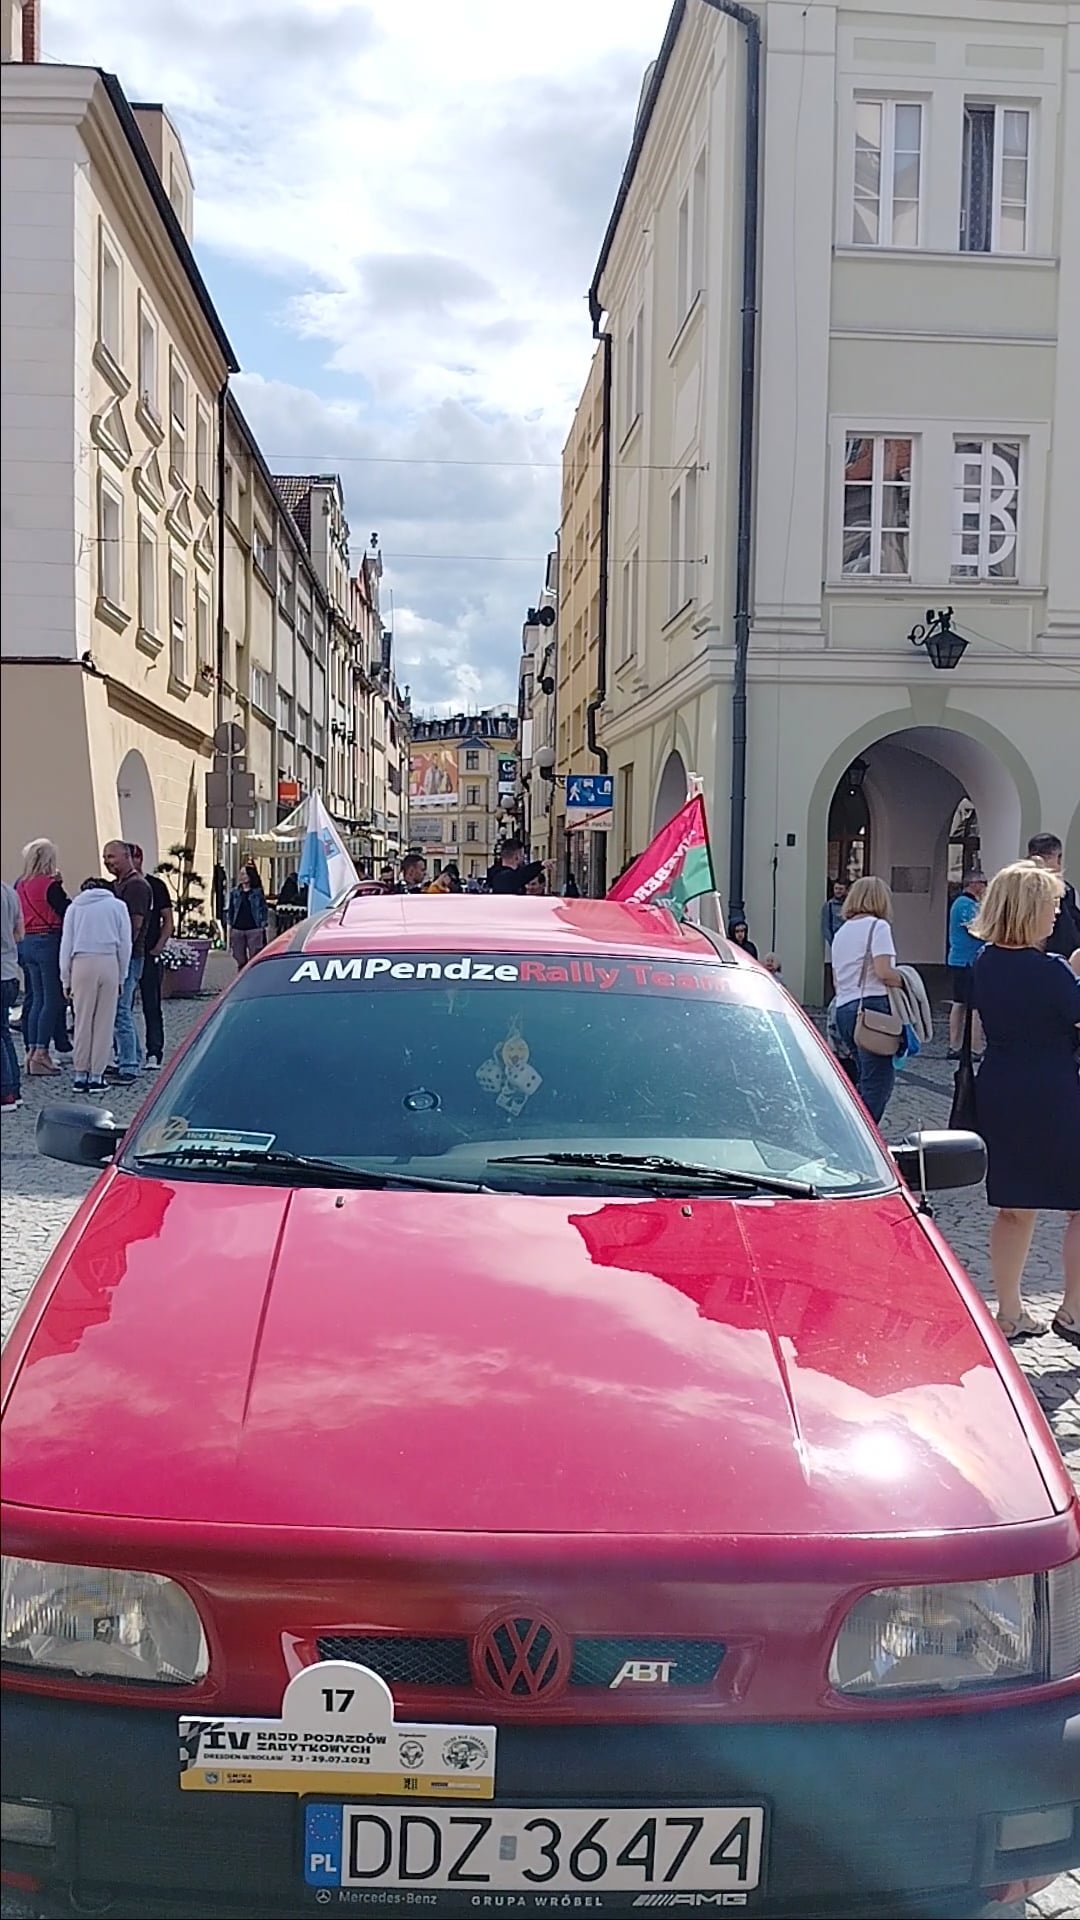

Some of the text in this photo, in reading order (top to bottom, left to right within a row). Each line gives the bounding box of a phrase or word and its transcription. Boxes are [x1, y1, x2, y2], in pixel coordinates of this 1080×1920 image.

[626, 962, 732, 992] Team
[608, 1661, 677, 1689] ABT
[321, 1689, 355, 1713] 17
[203, 1731, 252, 1750] IV
[256, 1732, 299, 1742] RAJD
[303, 1732, 387, 1745] POJAZDÓW
[256, 1742, 371, 1754] ZABYTKOWYCH
[291, 1754, 304, 1763] 23
[311, 1755, 370, 1765] 29.07.2023
[349, 1813, 751, 1882] DDZ 36474
[310, 1853, 337, 1873] PL
[338, 1890, 438, 1906] Mercedes-Benz
[471, 1892, 604, 1907] GRUPA WRÓBEL
[668, 1892, 748, 1907] AMG
